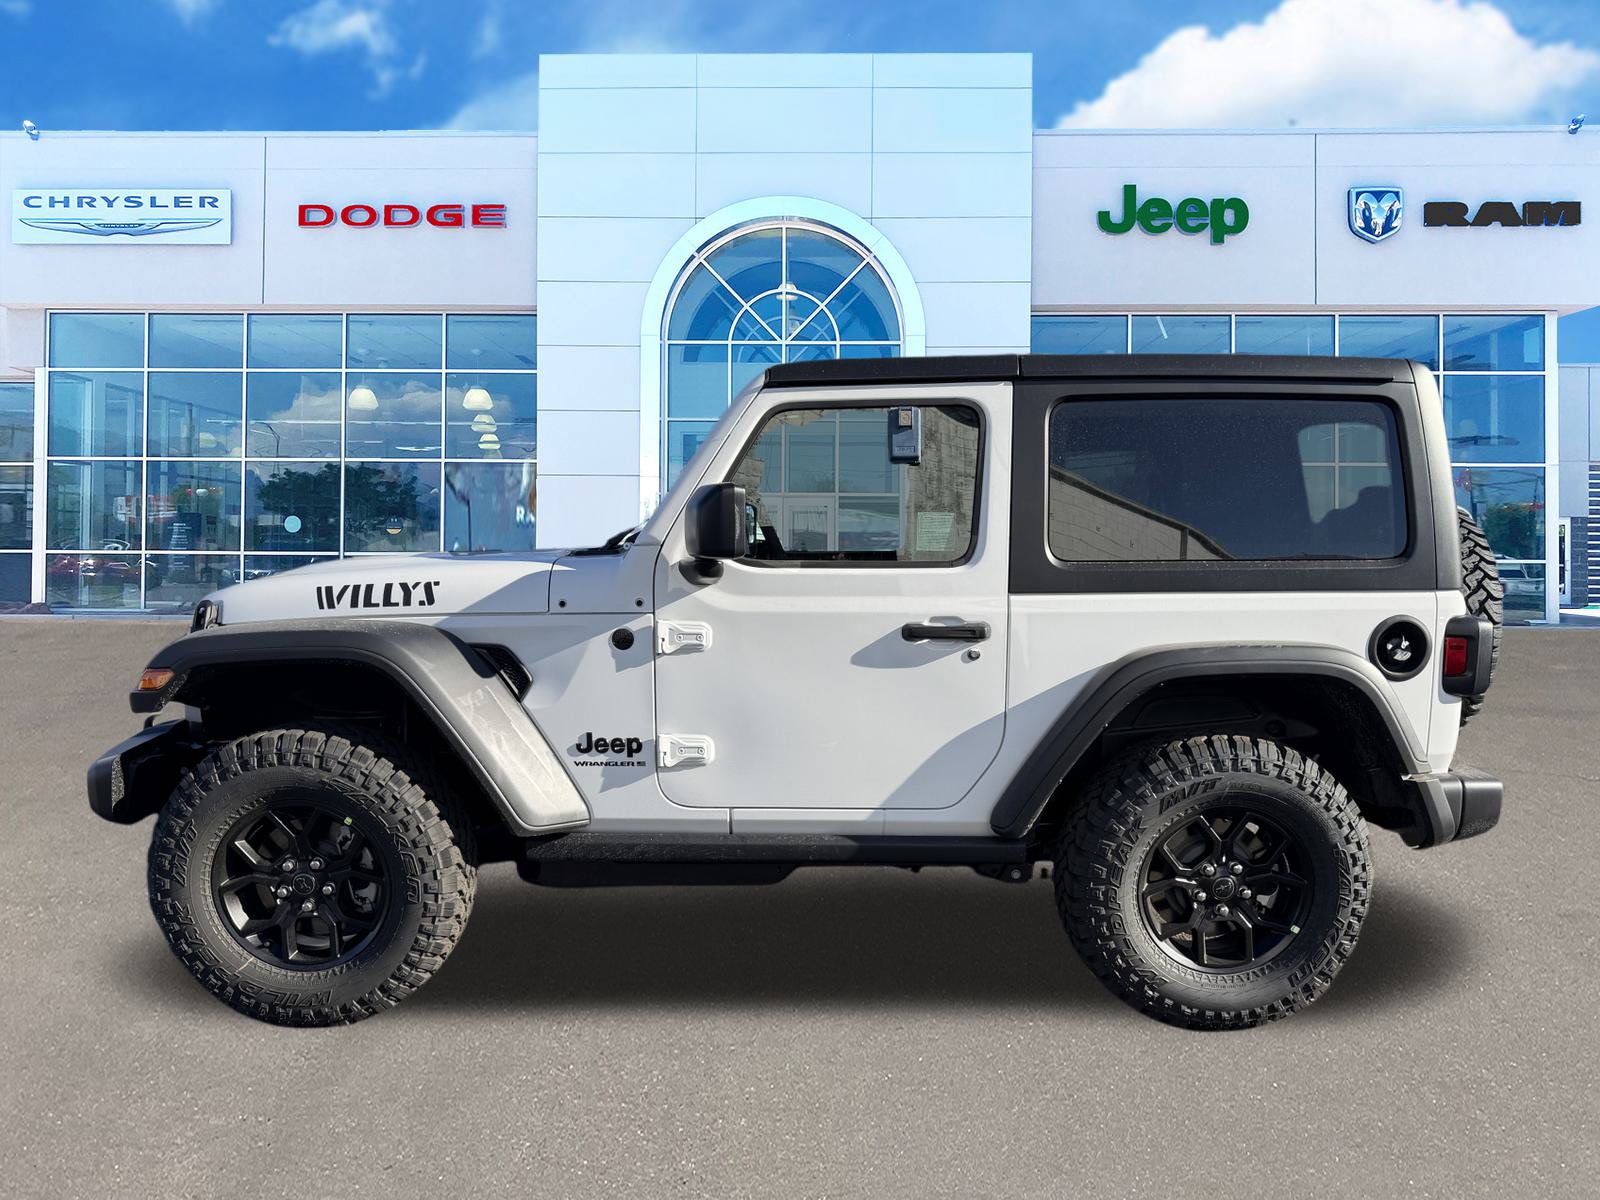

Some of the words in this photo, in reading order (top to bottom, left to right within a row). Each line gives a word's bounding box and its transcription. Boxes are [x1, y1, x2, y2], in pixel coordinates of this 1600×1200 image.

[23, 195, 219, 209] CHRYSLER
[1097, 184, 1249, 244] Jeep
[1423, 201, 1582, 227] RAM
[298, 204, 507, 228] DODGE
[316, 581, 440, 610] WILLYS
[576, 732, 643, 758] Jeep
